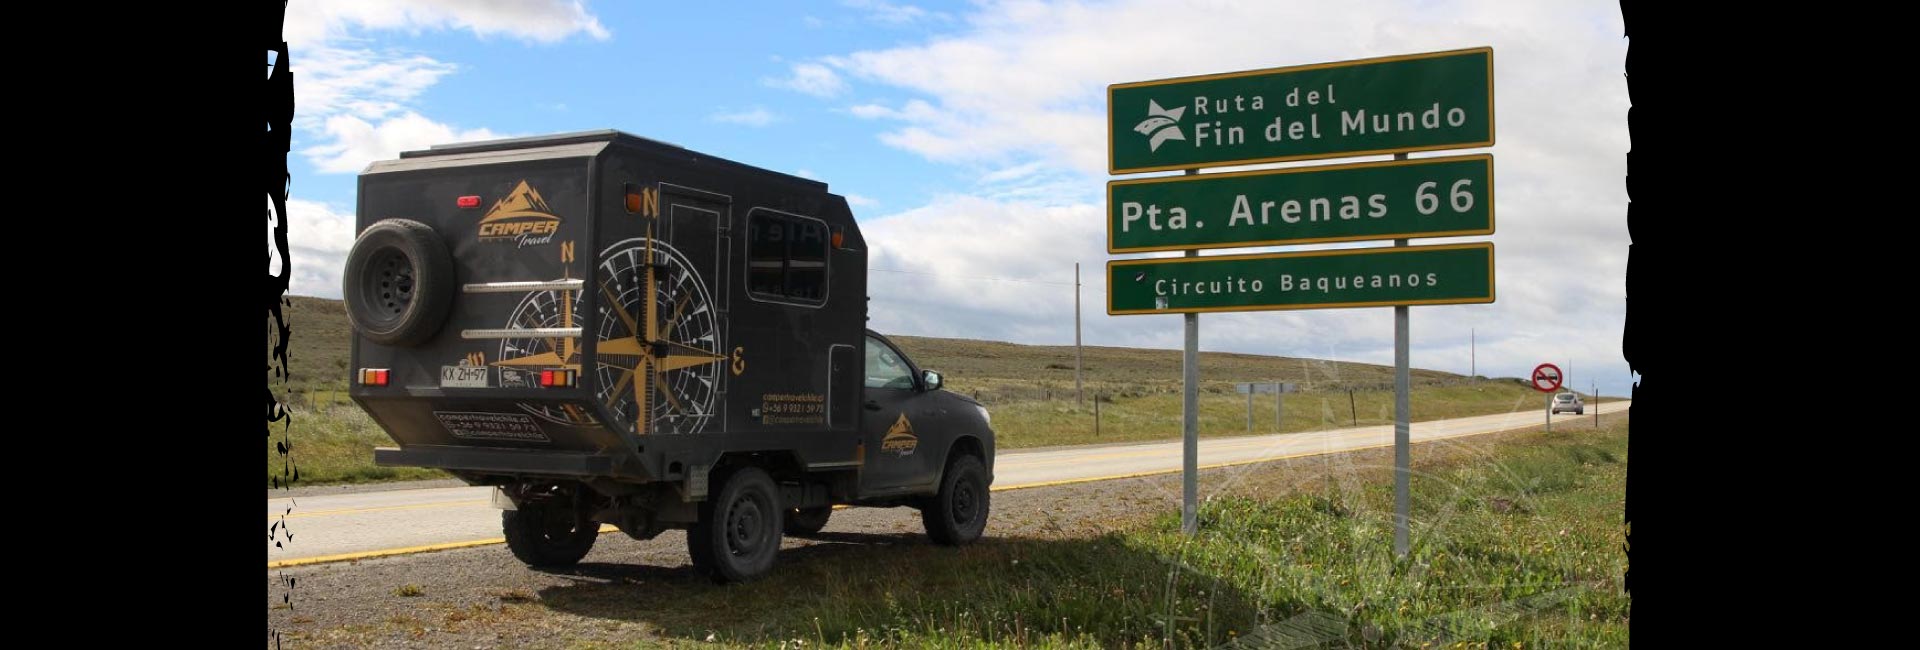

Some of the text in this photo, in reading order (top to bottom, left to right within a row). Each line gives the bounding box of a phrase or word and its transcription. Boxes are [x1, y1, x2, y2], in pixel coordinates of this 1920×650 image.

[1195, 85, 1336, 115] Ruta del
[1195, 103, 1467, 147] Fin del Mundo
[642, 187, 658, 218] N
[1122, 178, 1475, 232] Pta. Arenas 66
[479, 221, 561, 237] CAMPER
[515, 232, 555, 249] Travel
[561, 241, 575, 263] N
[1155, 272, 1438, 296] Circuito Baqueanos
[442, 369, 455, 381] KX
[882, 440, 918, 449] CAMPER
